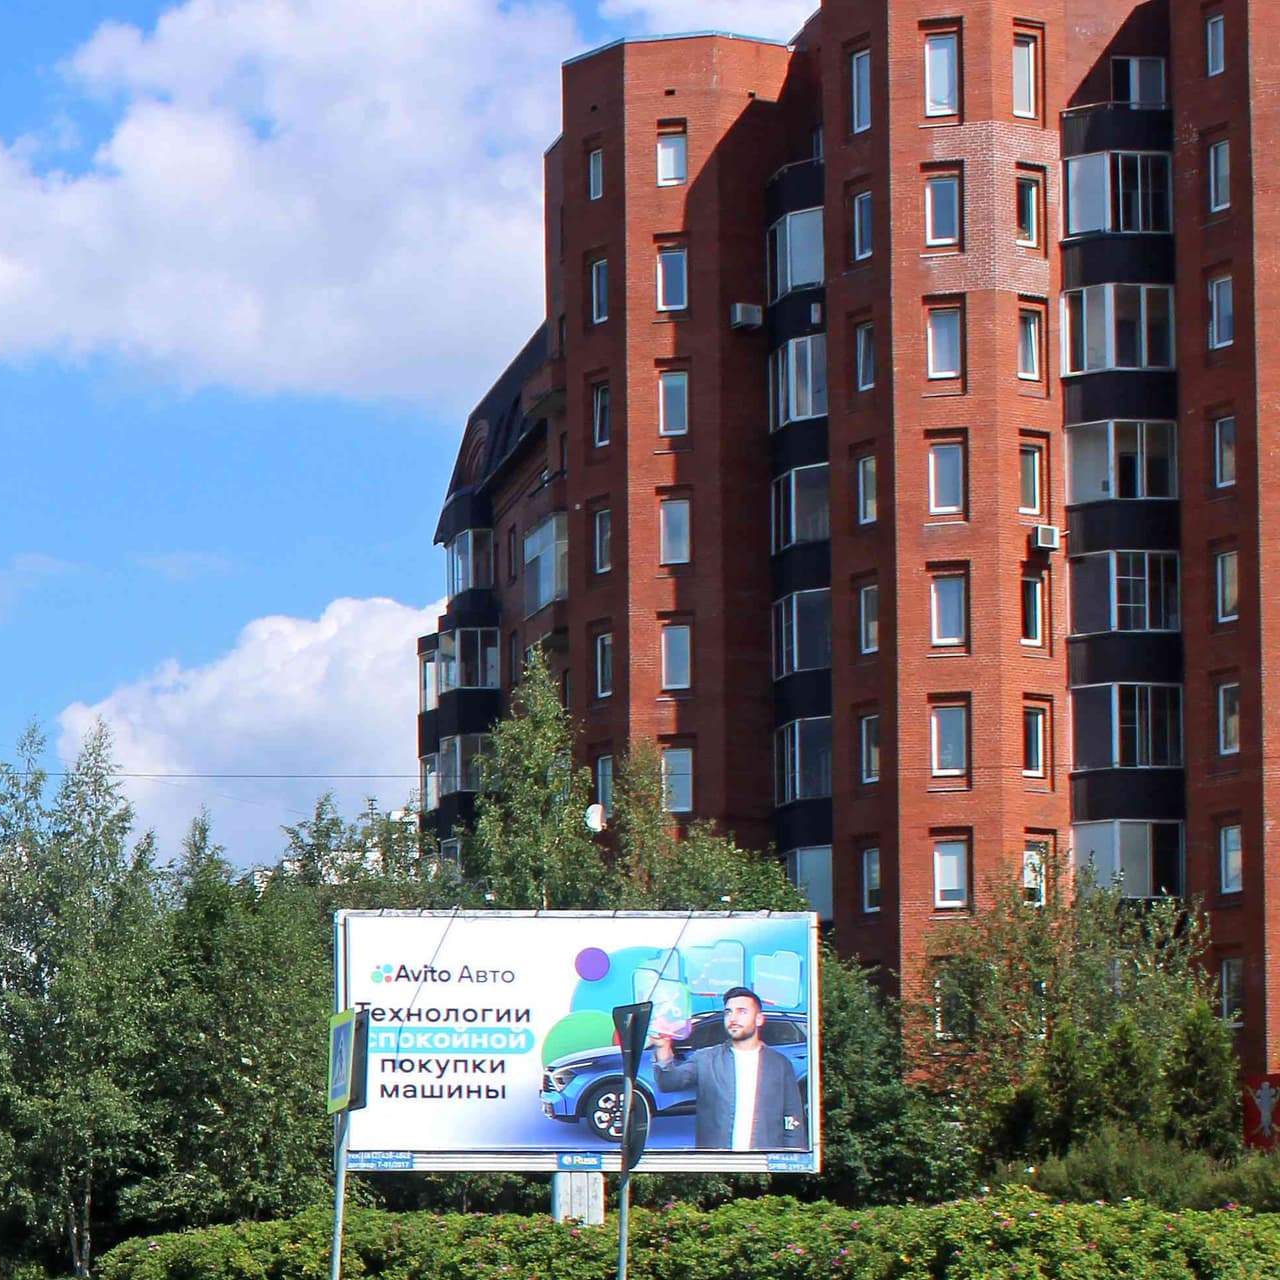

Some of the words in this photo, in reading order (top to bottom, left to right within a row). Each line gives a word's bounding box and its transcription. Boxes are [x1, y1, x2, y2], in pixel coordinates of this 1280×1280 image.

[395, 964, 451, 983] Avito
[458, 965, 515, 983] Авто
[368, 1027, 526, 1049] спокойной
[381, 1059, 505, 1079] покупки
[380, 1084, 506, 1099] машины
